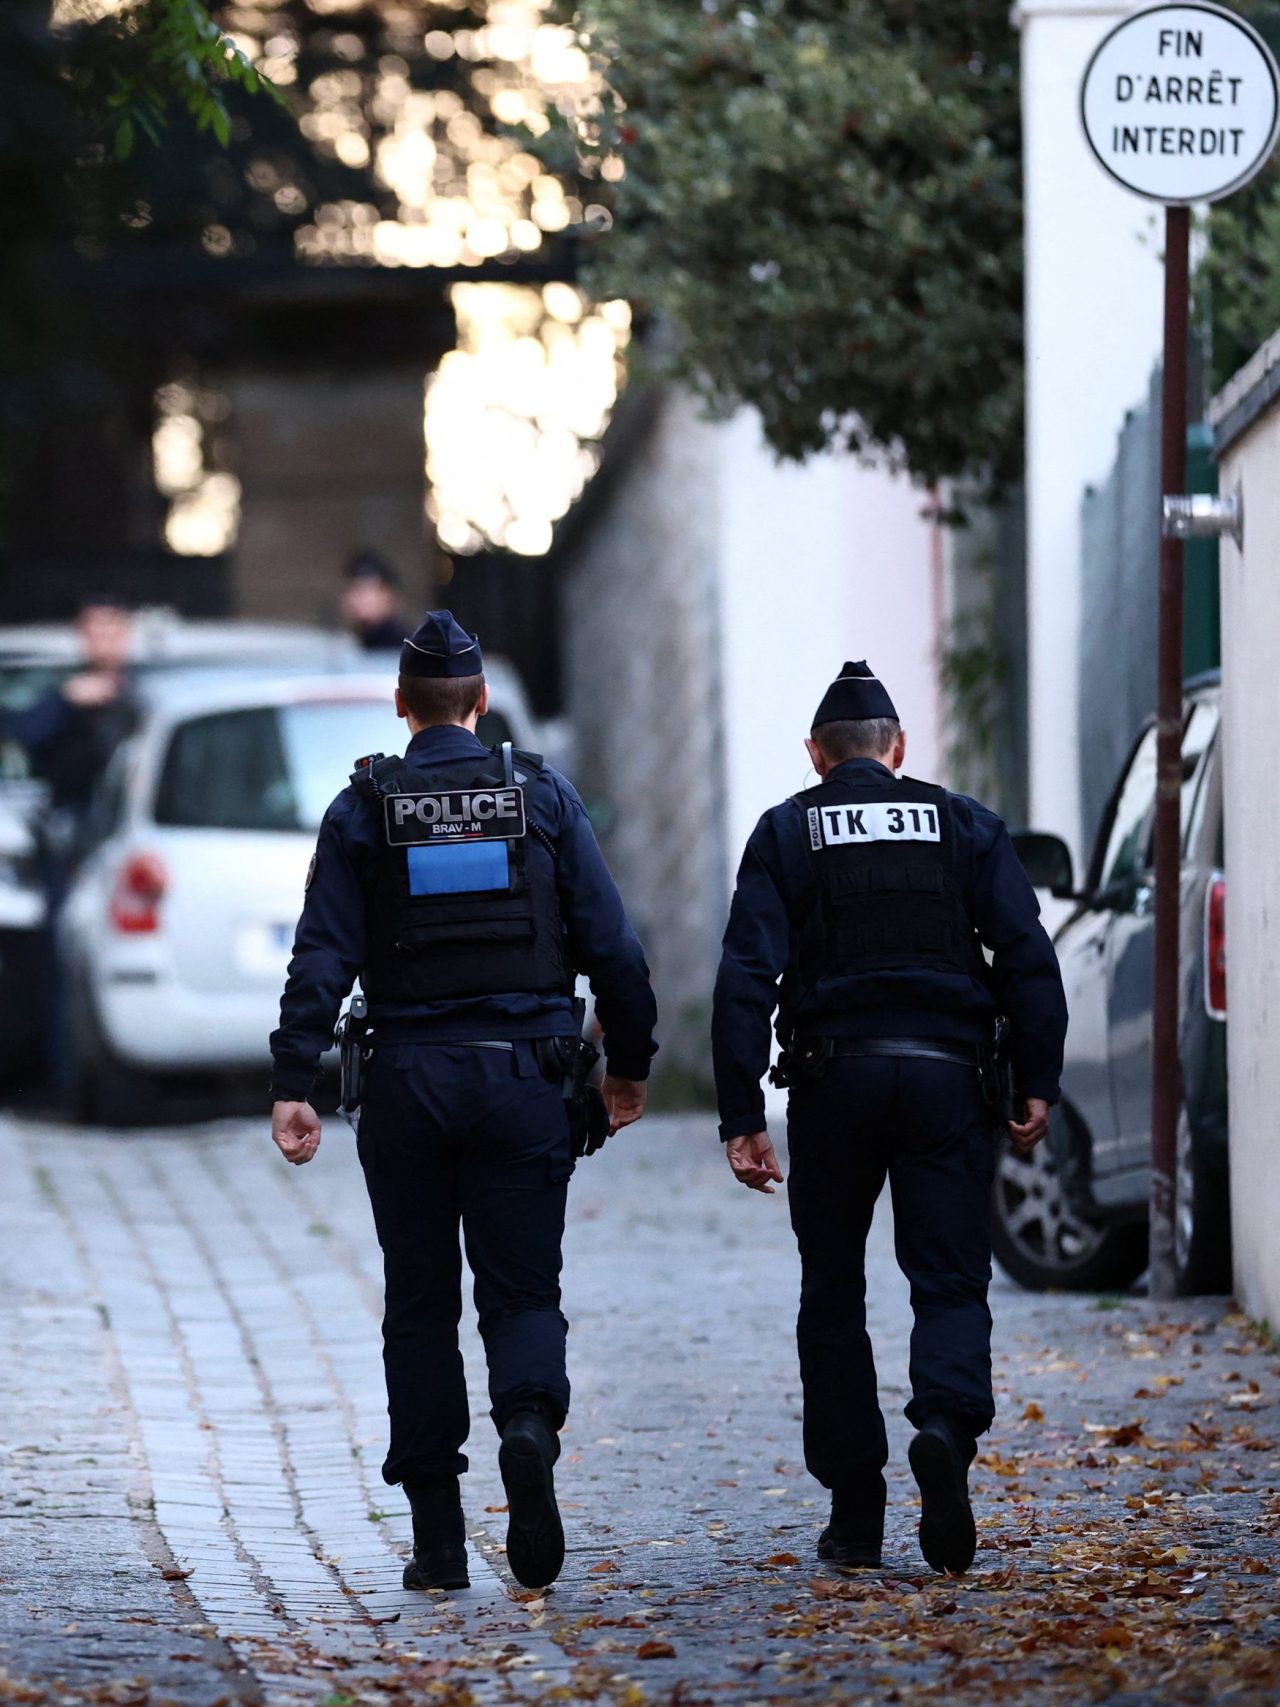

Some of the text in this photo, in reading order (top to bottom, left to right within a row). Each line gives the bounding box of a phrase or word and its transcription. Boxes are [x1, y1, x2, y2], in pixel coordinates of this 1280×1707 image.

[1159, 30, 1202, 57] FIN
[1117, 69, 1242, 104] D'ARRÊT
[1113, 126, 1245, 156] INTERDIT
[394, 792, 518, 825] POLICE
[825, 808, 937, 836] TK 311
[810, 809, 819, 847] POLICE
